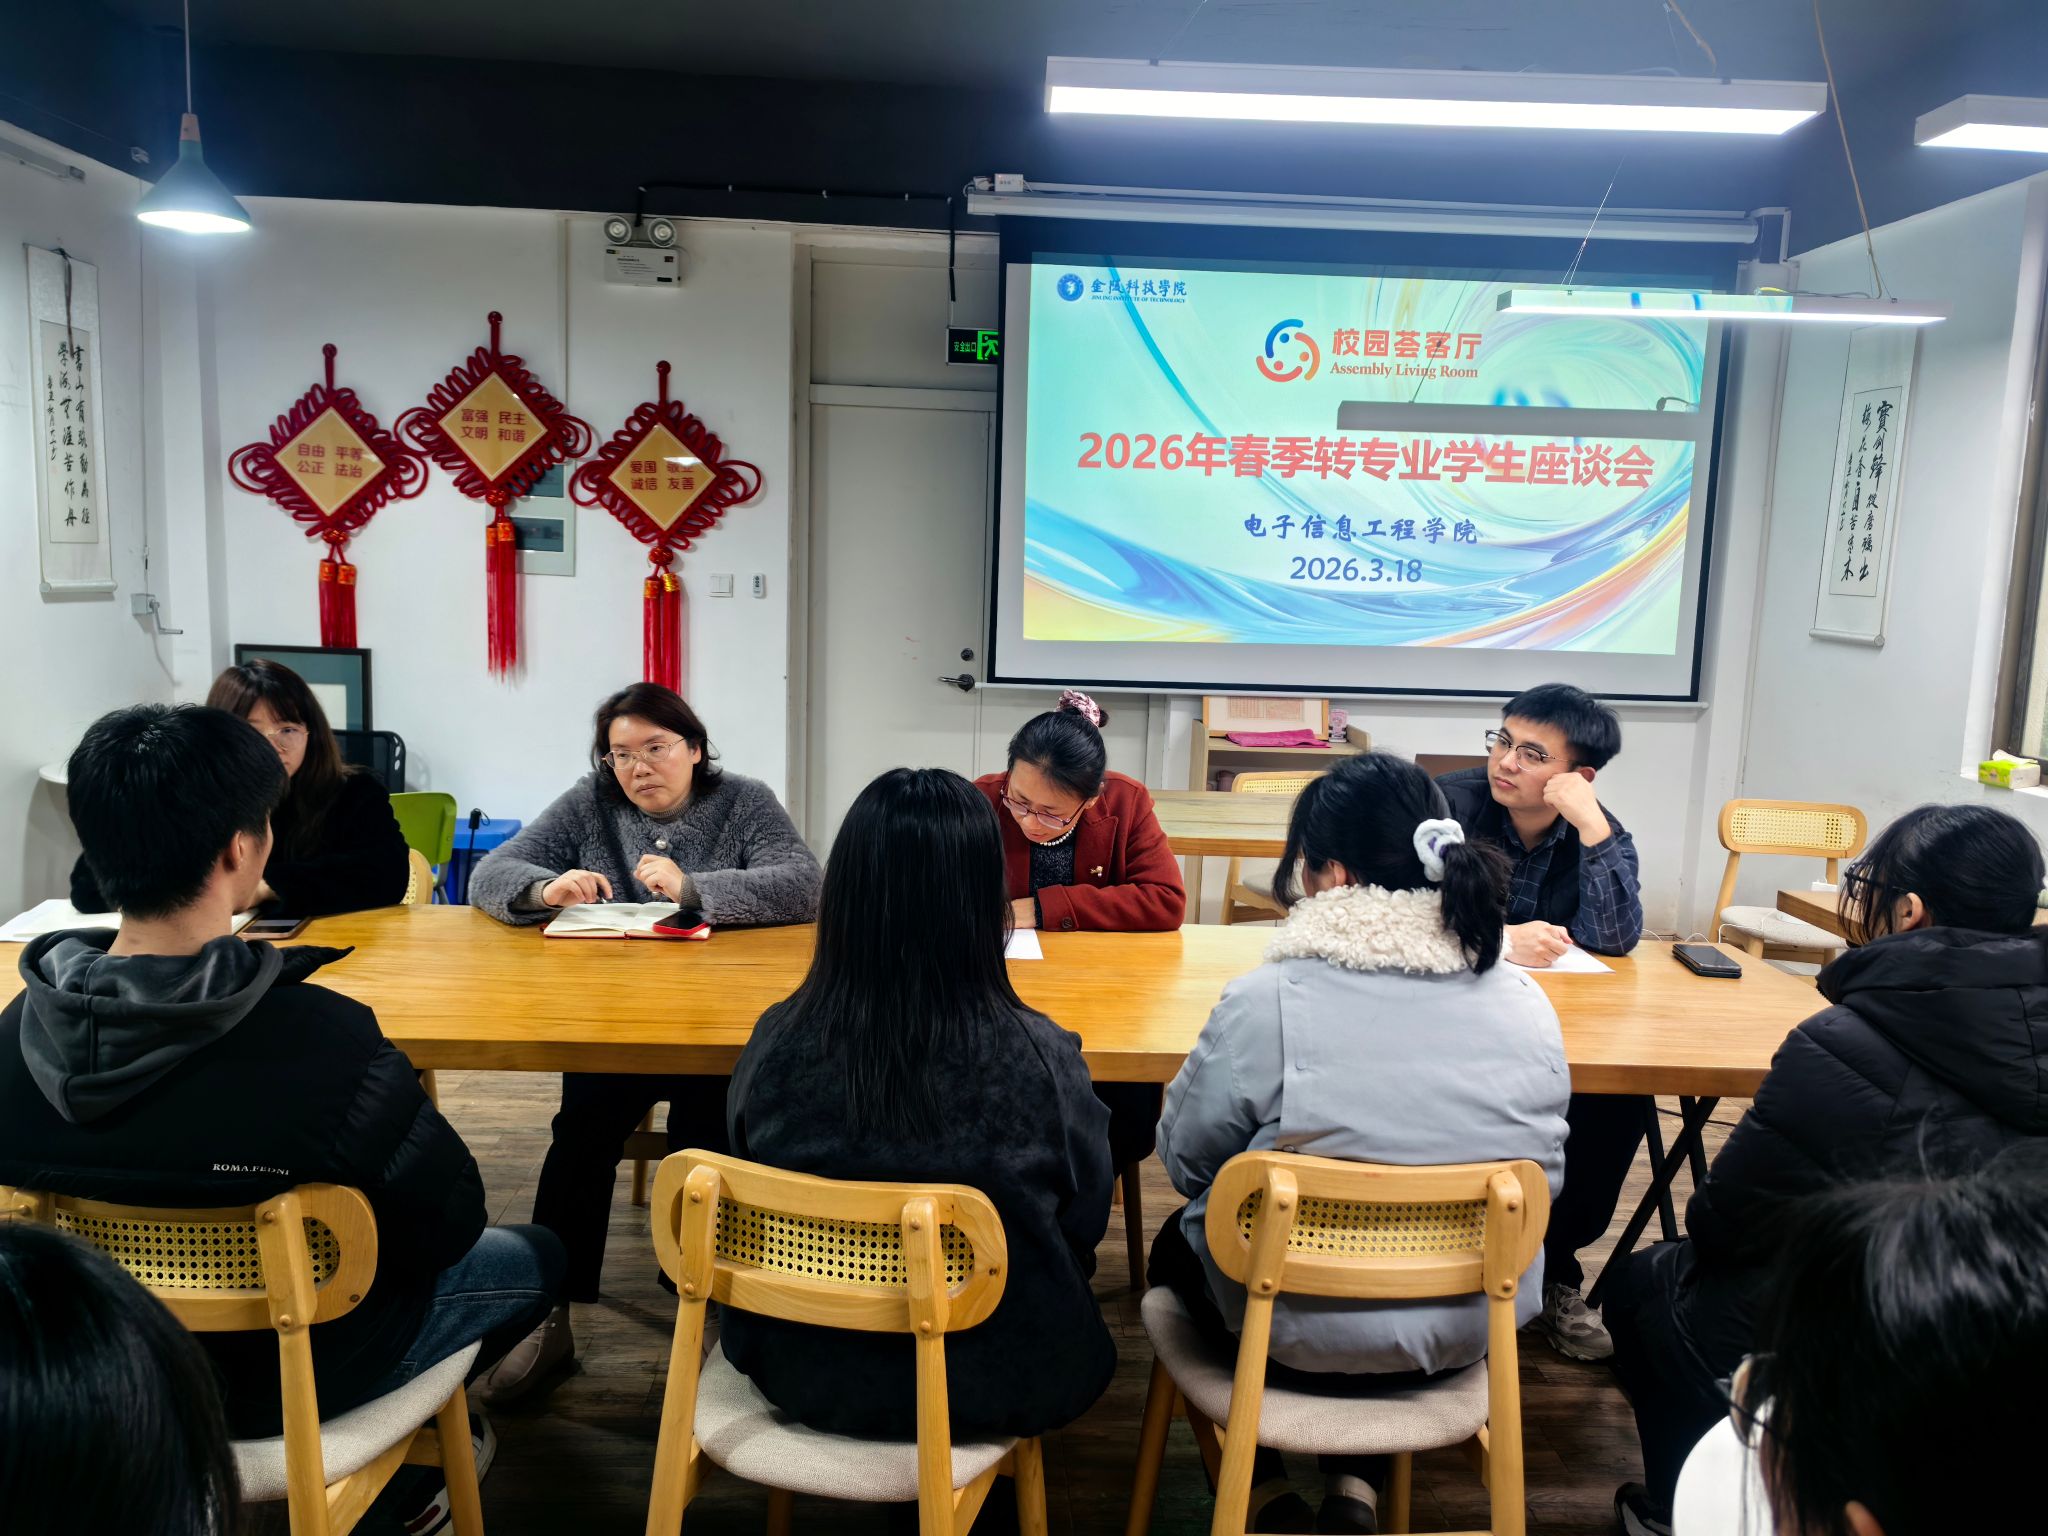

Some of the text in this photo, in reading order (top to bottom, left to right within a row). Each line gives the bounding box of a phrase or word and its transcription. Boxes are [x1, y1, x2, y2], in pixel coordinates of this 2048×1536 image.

[953, 341, 977, 352] 安全出口
[1331, 328, 1483, 360] 校园荟客厅
[1330, 362, 1479, 380] Assembly Living Room
[461, 408, 527, 425] 富强 民主
[461, 426, 526, 443] 文明 和谐
[298, 443, 363, 462] 自由 平等
[1077, 432, 1655, 489] 2026年春季转专业学生座谈会
[297, 460, 363, 478] 公正 法治
[630, 461, 657, 473] 爱国
[630, 477, 695, 490] 诚信 友善
[1244, 513, 1478, 544] 电子信息工程学院
[1290, 556, 1423, 583] 2026.3.18
